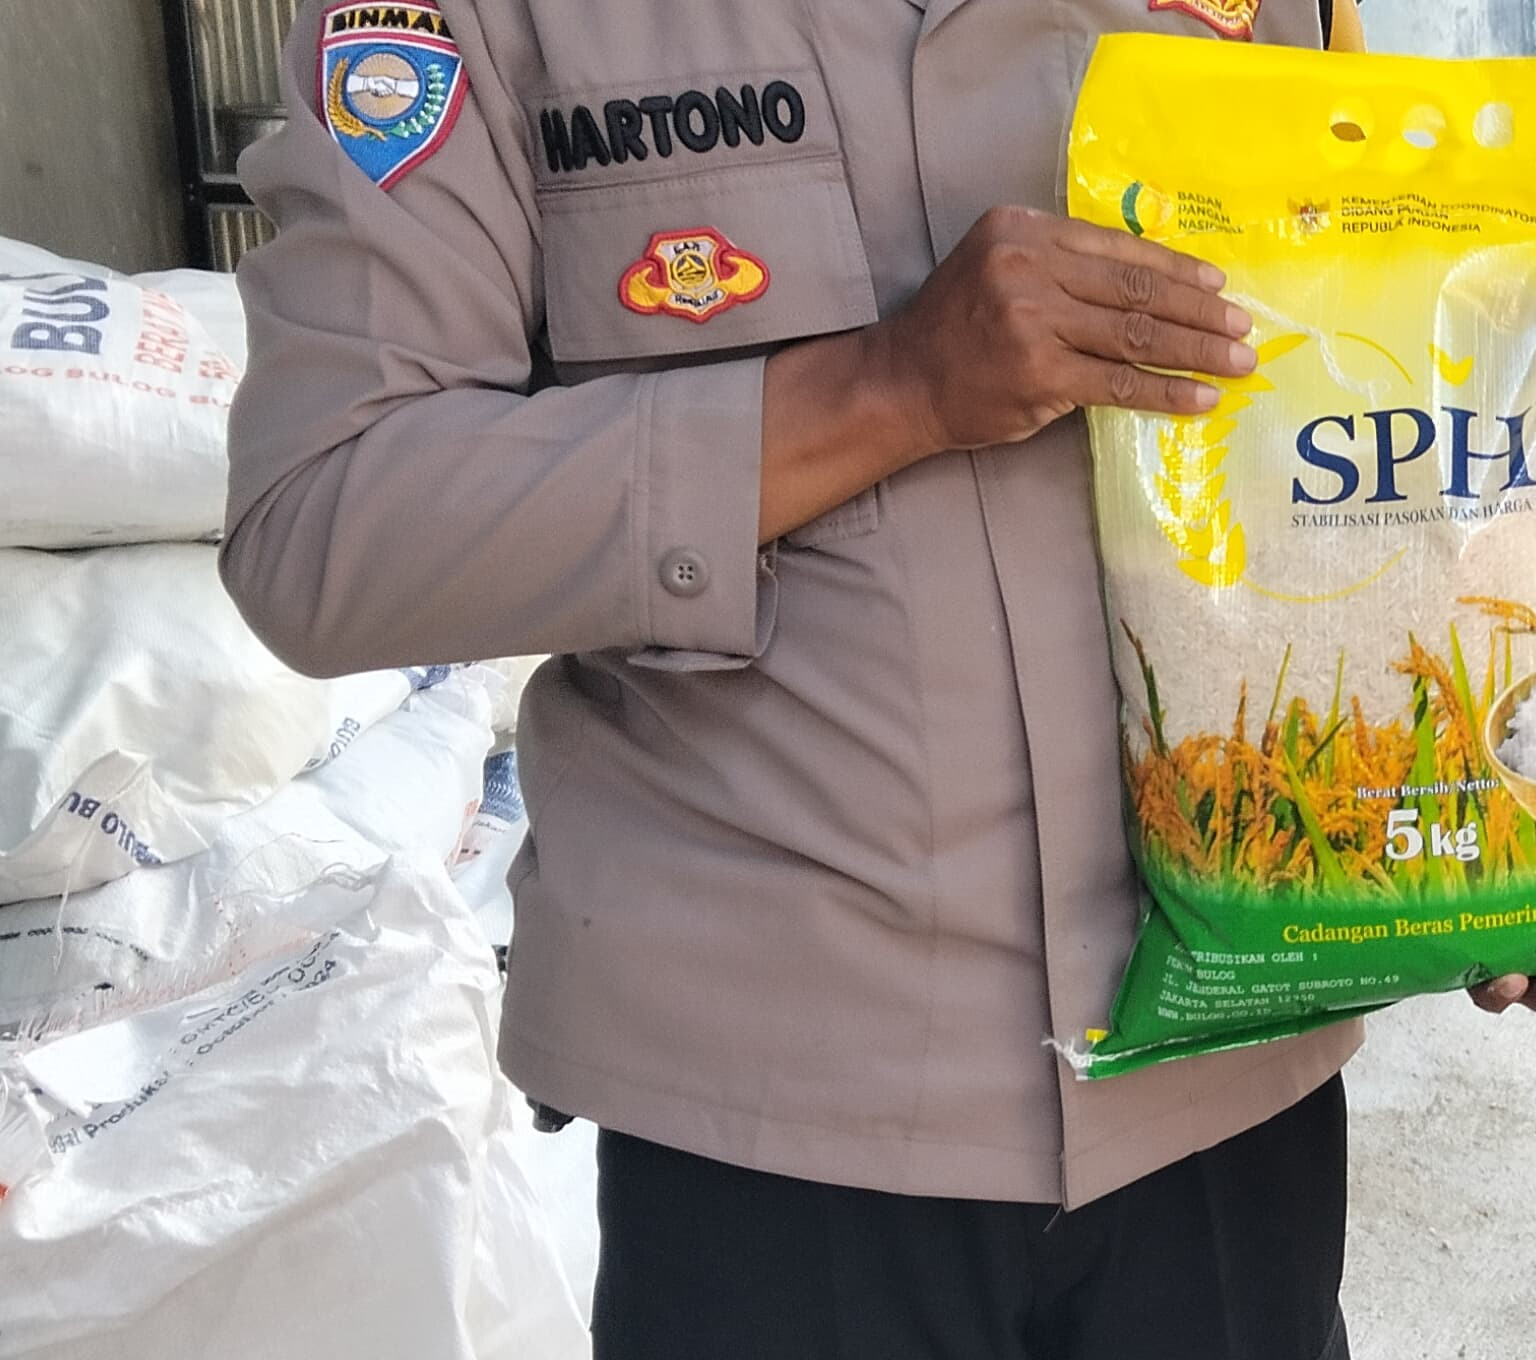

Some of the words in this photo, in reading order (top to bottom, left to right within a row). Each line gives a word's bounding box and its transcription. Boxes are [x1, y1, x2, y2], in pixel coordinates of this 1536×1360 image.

[540, 80, 806, 173] HARTONO
[1292, 513, 1379, 528] STABILISASI
[1384, 506, 1444, 527] PASOKAN
[1483, 498, 1531, 520] HARGA
[1386, 808, 1423, 861] 5
[1431, 822, 1480, 862] kg
[1283, 923, 1388, 944] Cadangan
[1395, 916, 1453, 937] Beras
[1271, 951, 1304, 963] OLEH
[1196, 969, 1236, 981] BULOG
[1251, 983, 1292, 994] GATOT
[1298, 978, 1354, 990] SUBROTO
[1160, 990, 1208, 1009] JAKARTA
